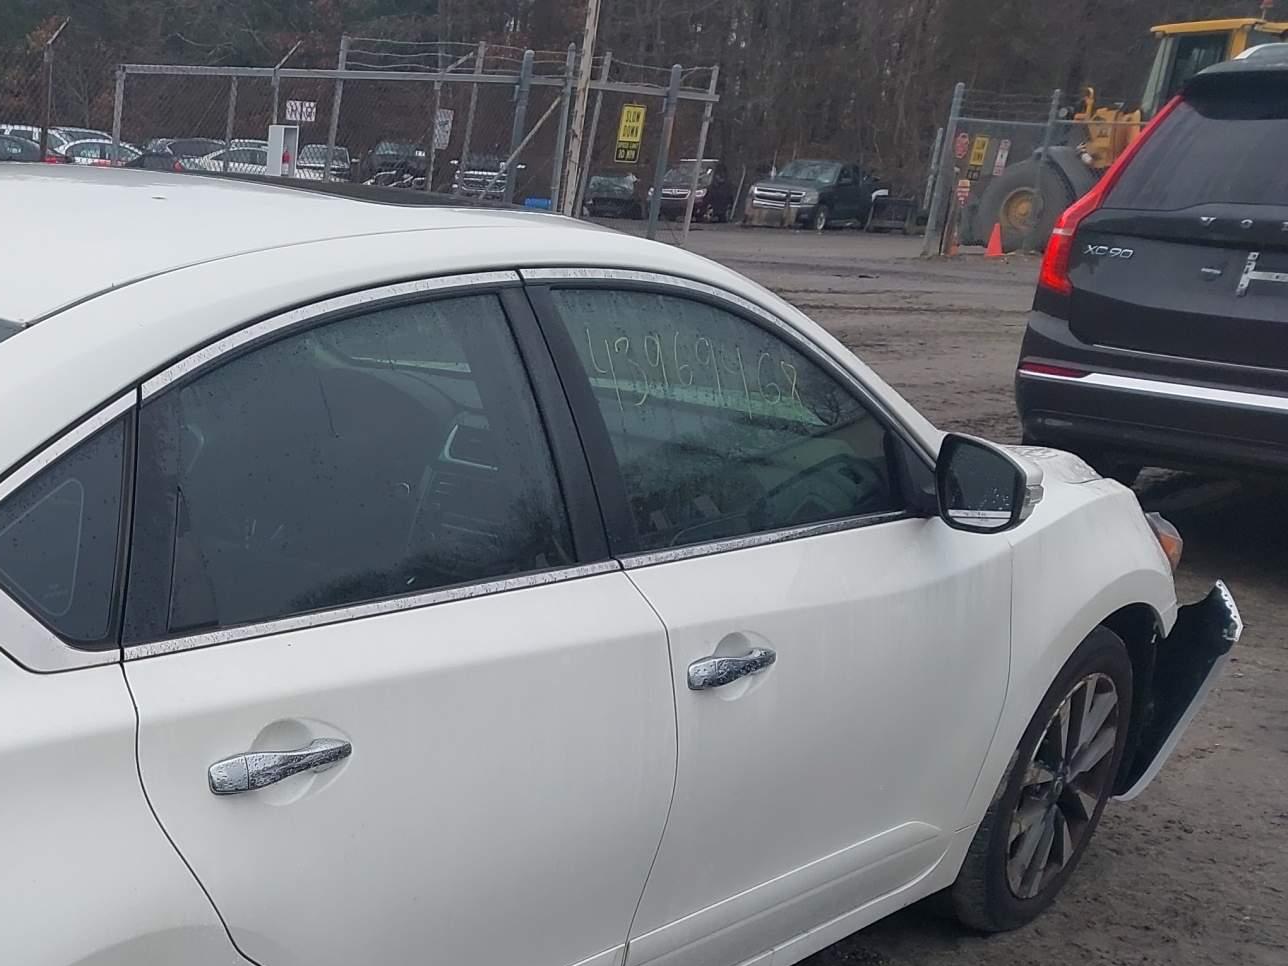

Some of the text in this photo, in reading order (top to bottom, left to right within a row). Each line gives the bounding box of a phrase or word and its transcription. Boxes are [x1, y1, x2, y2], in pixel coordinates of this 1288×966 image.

[625, 110, 642, 123] SLOW
[622, 124, 639, 138] DOWN
[586, 328, 804, 420] 43969468
